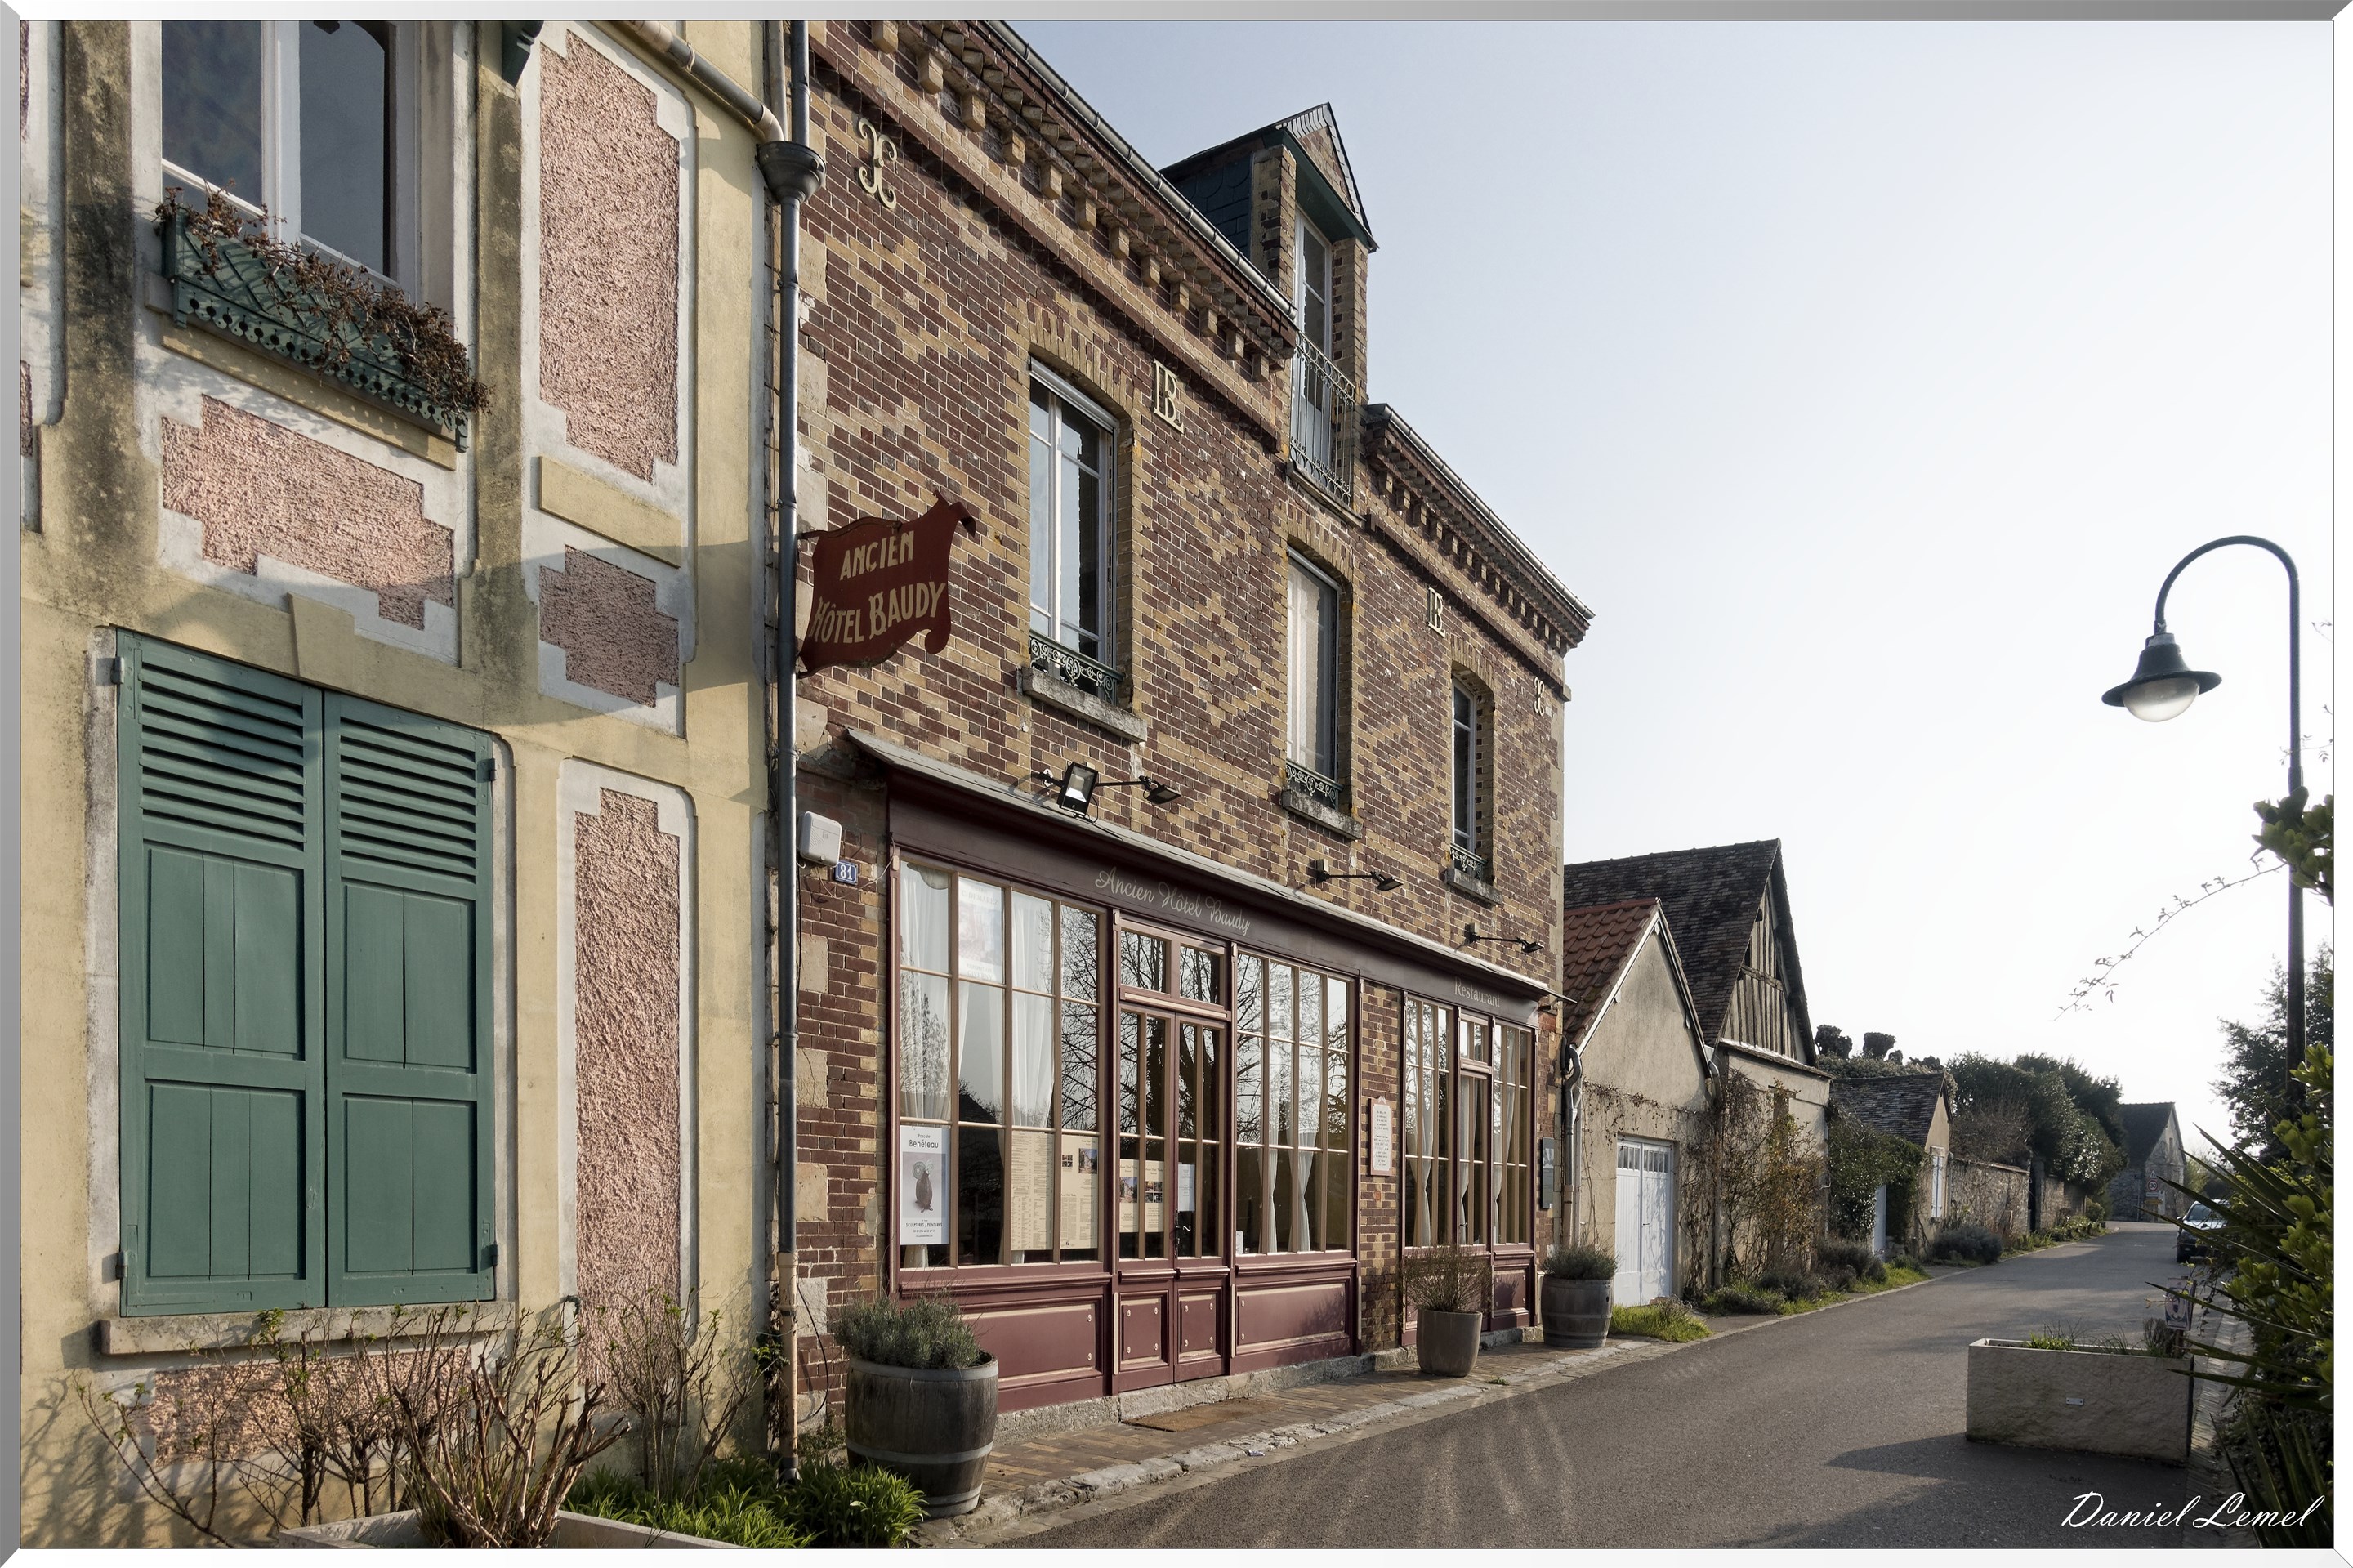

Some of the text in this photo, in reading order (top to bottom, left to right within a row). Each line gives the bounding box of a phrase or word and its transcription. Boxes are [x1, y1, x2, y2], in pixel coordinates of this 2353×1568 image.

[840, 530, 914, 581] ANCIEN
[809, 581, 946, 644] HÔTEL BAUDY
[840, 864, 853, 881] 81
[1095, 867, 1251, 936] Ancien Hôtel Baudy
[1454, 976, 1501, 1008] Restaurant
